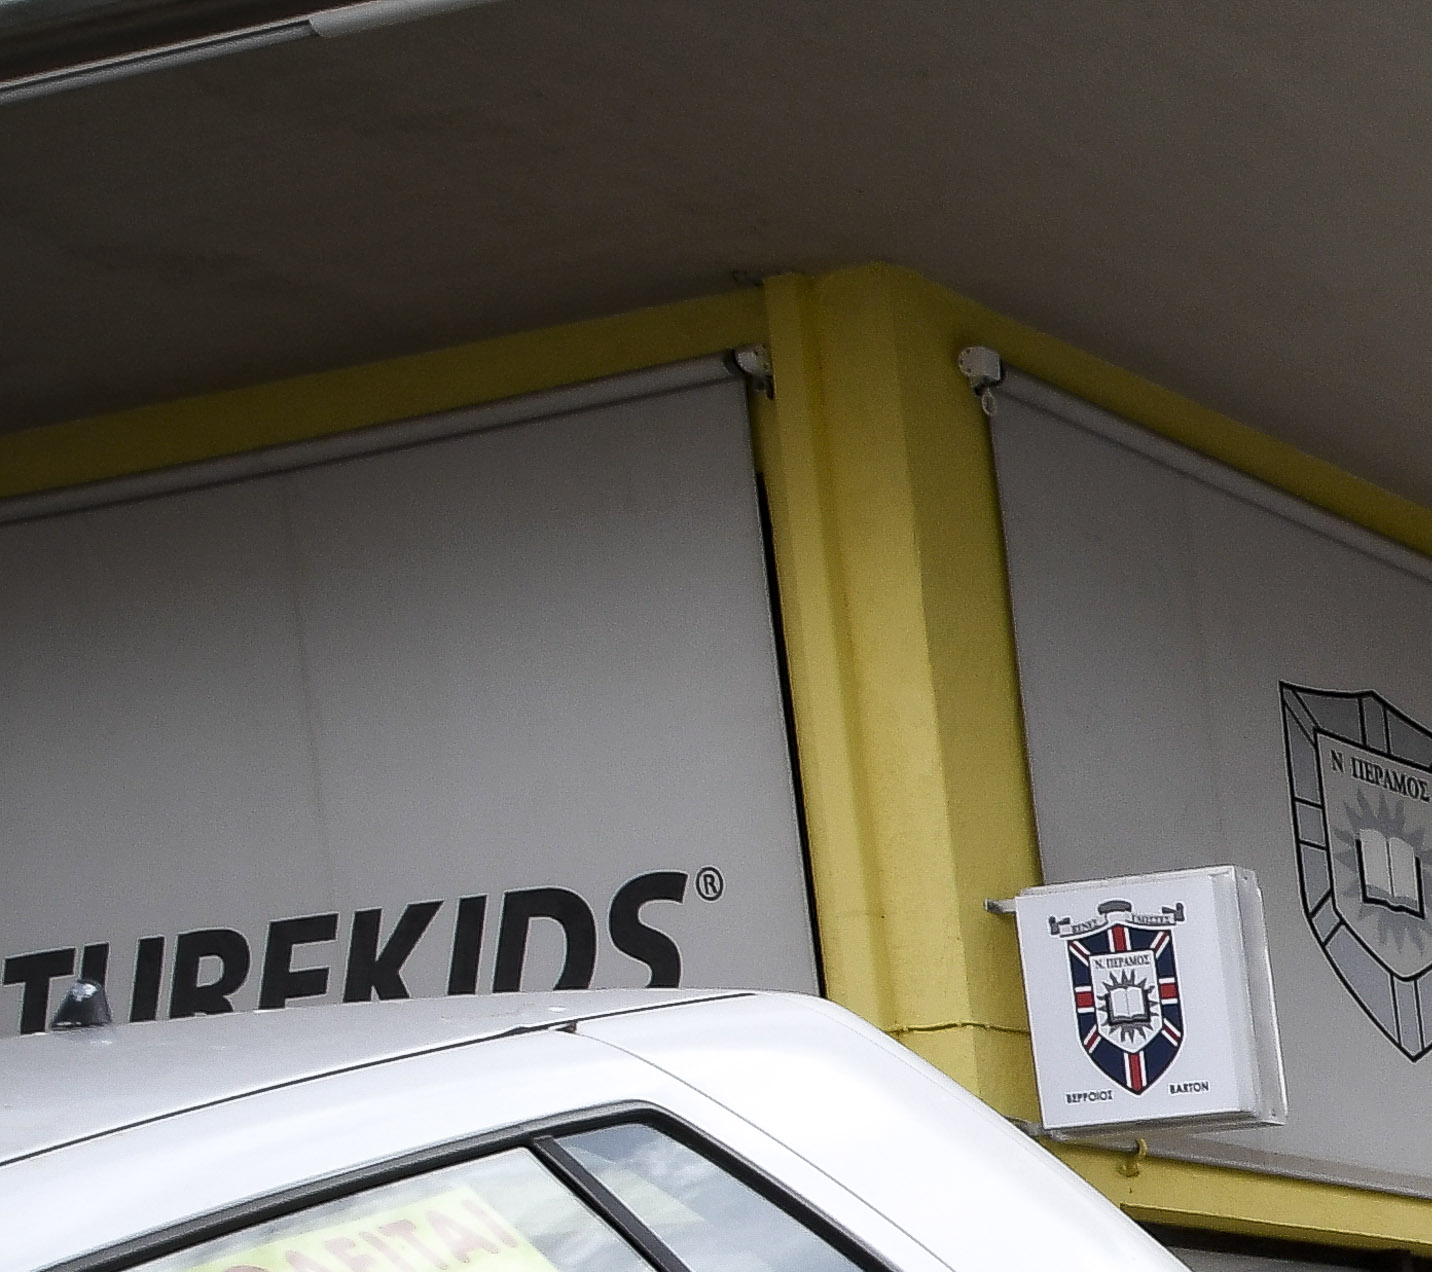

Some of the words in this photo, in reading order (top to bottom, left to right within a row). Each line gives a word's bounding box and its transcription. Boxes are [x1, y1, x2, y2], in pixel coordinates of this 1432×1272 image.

[1350, 756, 1431, 802] ΠΕΡΑΜΟΣ
[1105, 954, 1152, 969] ΠΕΡΑΜΟΣ
[1169, 1081, 1210, 1095] BARTON
